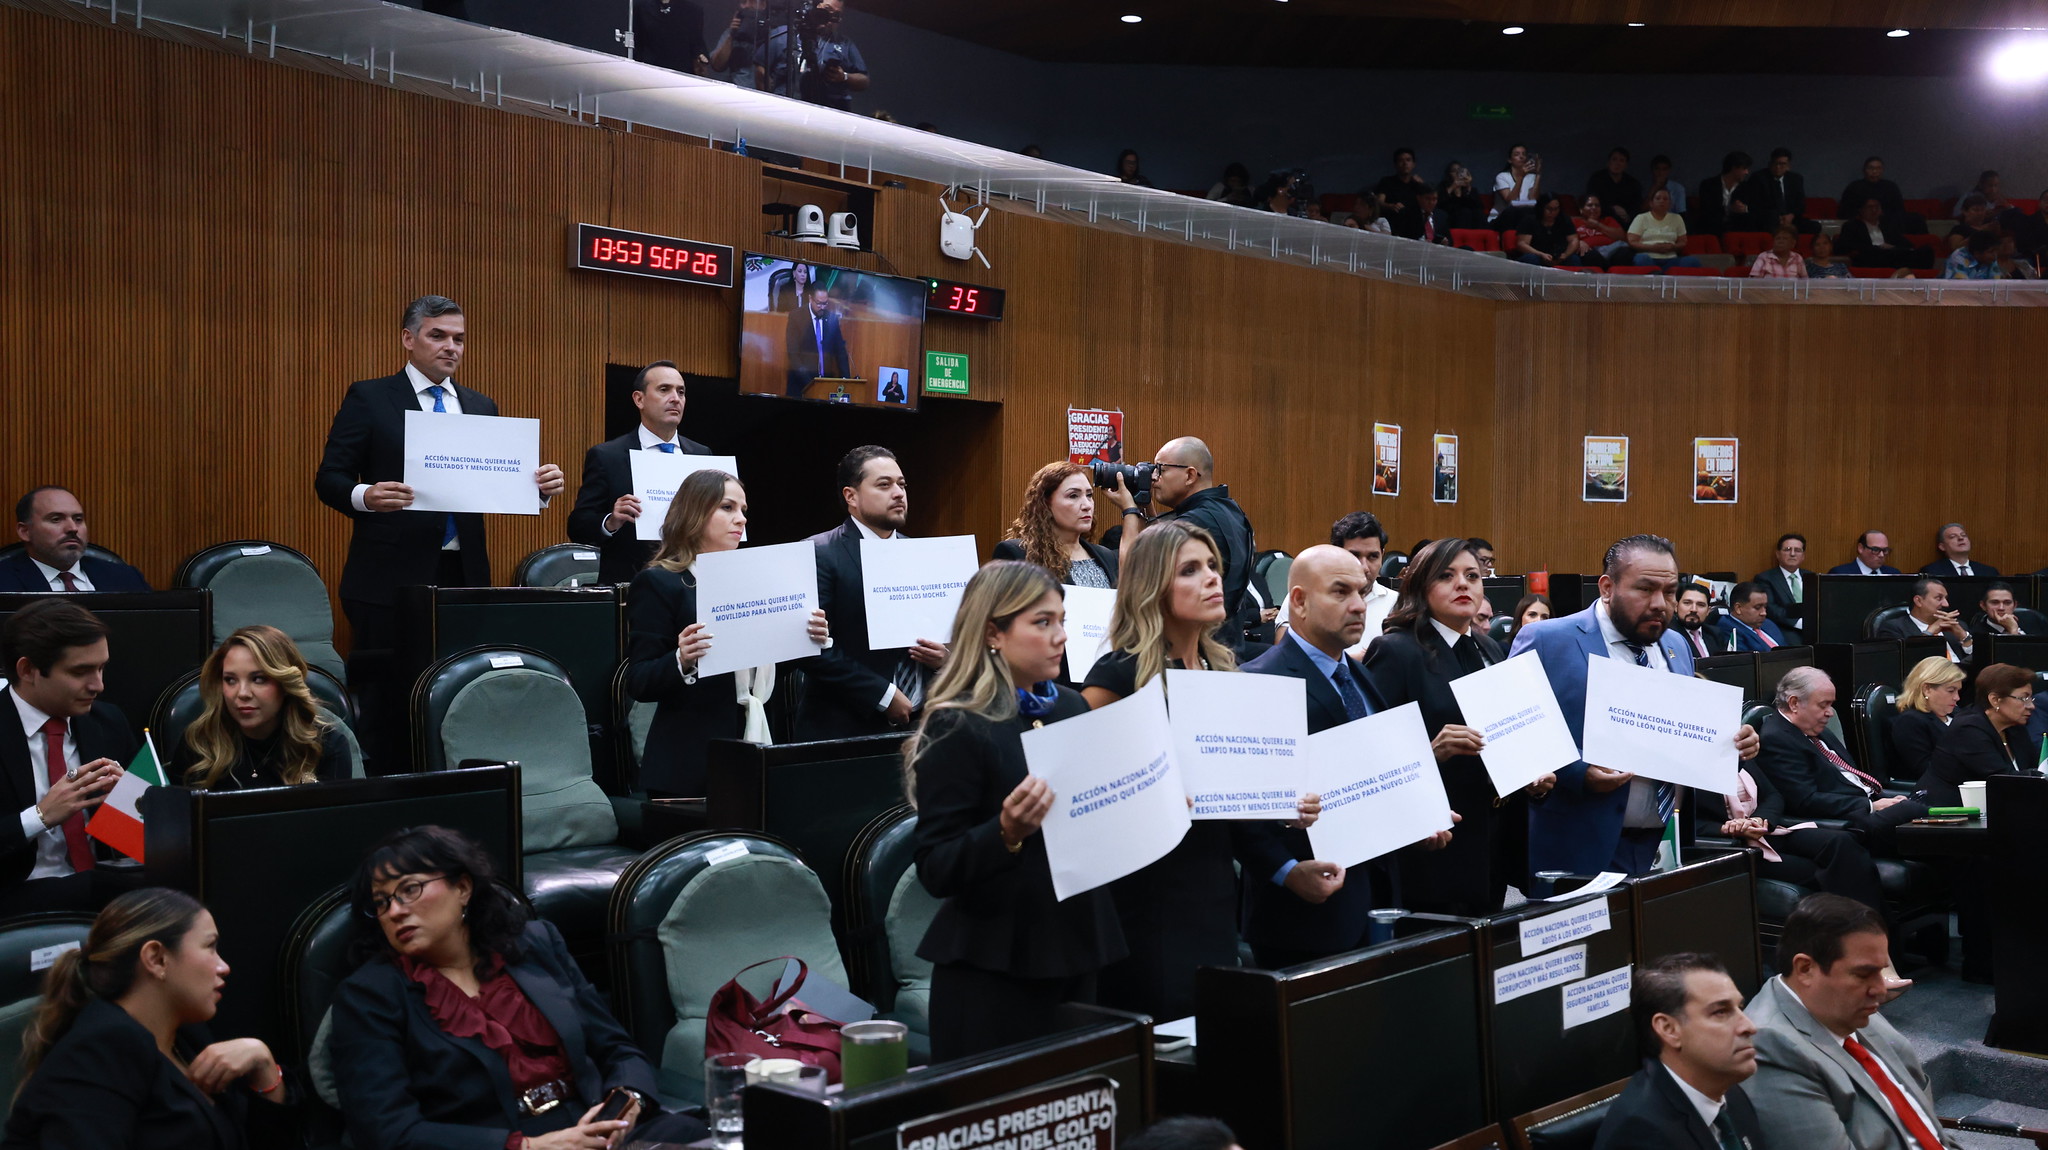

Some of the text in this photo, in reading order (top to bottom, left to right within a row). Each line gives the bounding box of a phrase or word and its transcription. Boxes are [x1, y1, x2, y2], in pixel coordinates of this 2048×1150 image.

[593, 238, 718, 276] 13:53 SEP 26
[949, 287, 978, 312] 35
[936, 356, 959, 368] SALIDA
[944, 368, 952, 378] DE
[928, 377, 966, 390] EMERGENCIA
[1070, 424, 1109, 434] PRESIDENTA
[1084, 434, 1109, 442] APOYAR
[872, 585, 892, 593] ACCIÓN
[712, 592, 806, 613] ACCIÓN NACIONAL QUIERE MEJOR
[716, 612, 750, 622] MOVILIDAD
[768, 604, 788, 614] NUEVO
[788, 602, 804, 610] LEÓN.
[1498, 714, 1518, 727] NACIONAL
[1518, 706, 1533, 718] QUIERE
[1608, 706, 1717, 736] ACCIÓN NACIONAL QUIERE UN
[1196, 734, 1224, 742] ACCIÓN
[1226, 736, 1260, 744] NACIONAL
[1262, 737, 1284, 746] QUIERE
[1486, 730, 1505, 742] GOBIERNO
[1504, 726, 1512, 734] QUE
[1512, 720, 1526, 730] RINDA
[1610, 715, 1635, 726] NUEVO
[1636, 721, 1656, 731] LEÓN
[1657, 726, 1672, 735] QUE
[1682, 732, 1714, 743] AVANCE.
[1200, 746, 1228, 754] LIMPIO
[1248, 748, 1268, 756] TODAS
[1072, 785, 1108, 804] ACCIÓN
[1109, 768, 1148, 790] NACIONAL
[1320, 761, 1422, 802] CCIÓN NACIONAL QUIERE MEJOR
[1070, 794, 1118, 818] GOBIERNO
[1120, 786, 1136, 800] QUE
[1137, 776, 1156, 792] RINDA
[1194, 788, 1296, 802] ACCIÓN NACIONAL QUIERE MÁS
[1322, 794, 1361, 812] MOVILIDAD
[1362, 787, 1380, 798] PARA
[1380, 778, 1404, 791] NUEVO
[1195, 804, 1241, 814] RESULTADOS
[1248, 803, 1270, 812] MENOS
[1524, 908, 1608, 938] ACCIÓN NACIONAL QUIERE DECIRLE
[1542, 934, 1558, 944] ADIÓS
[1562, 930, 1572, 939] LOS
[1498, 952, 1584, 984] ACCIÓN NACIONAL QUIERE MENOS
[1498, 978, 1532, 996] CORRUPCIÓN
[1537, 972, 1548, 982] MÁS
[1549, 963, 1582, 979] RESULTADOS.
[1566, 982, 1630, 1010] SEGURIDAD PARA NUESTRAS
[1567, 972, 1628, 998] ACCIÓN NACIONAL QUIERE
[998, 1088, 1112, 1137] PRESIDENTA
[1020, 1127, 1054, 1150] DEL
[1054, 1110, 1112, 1143] GOLFO
